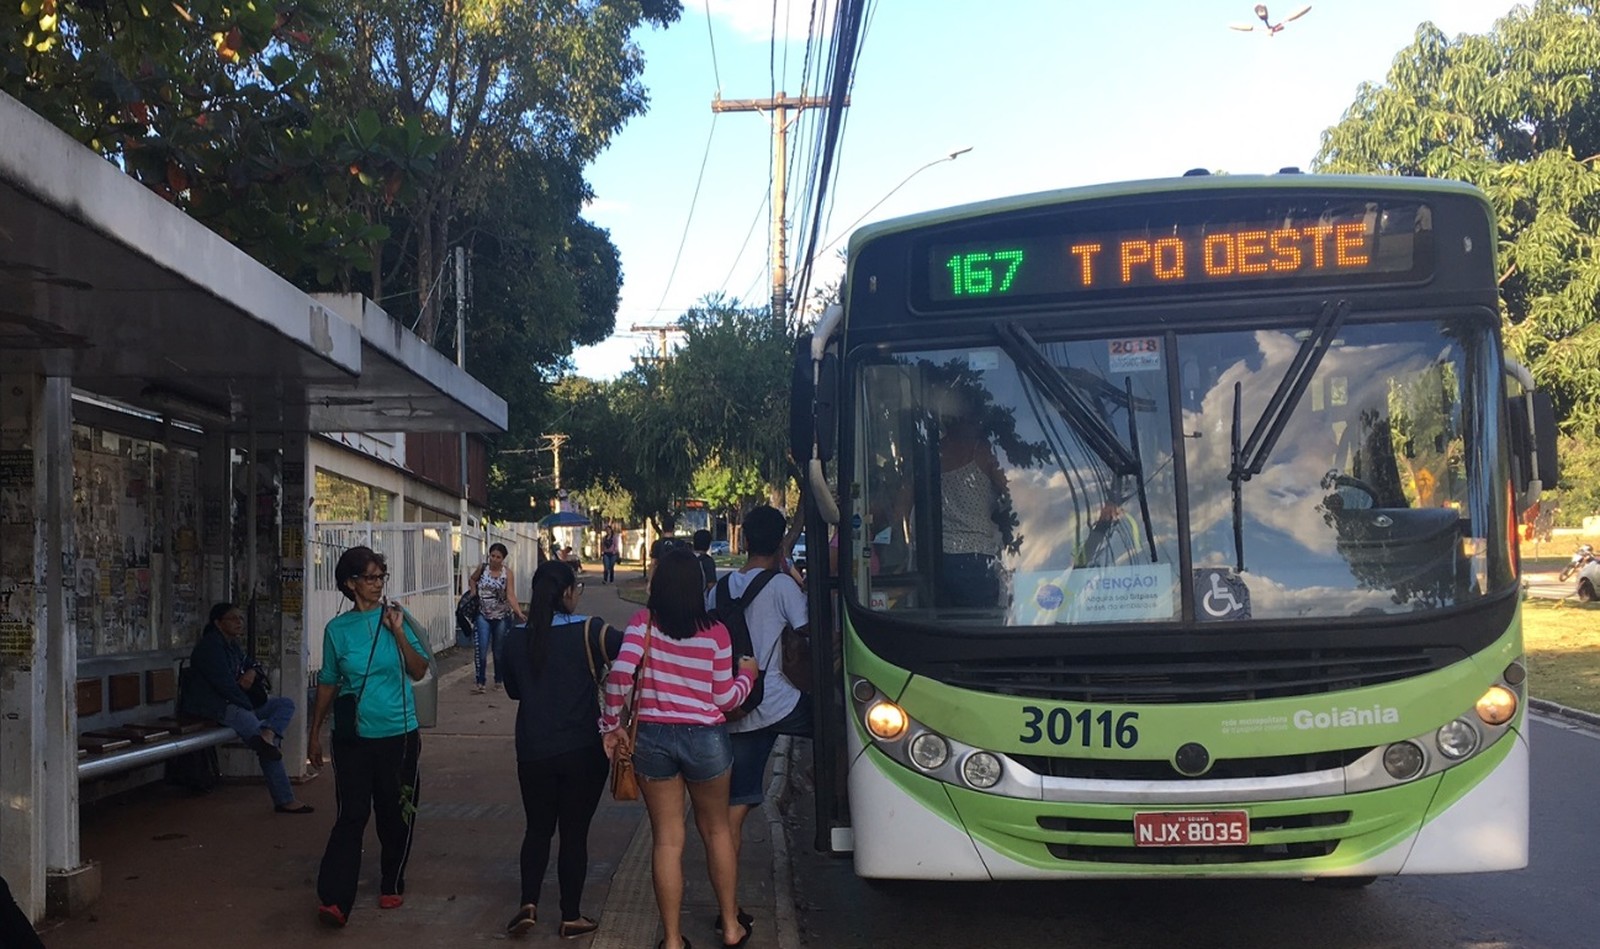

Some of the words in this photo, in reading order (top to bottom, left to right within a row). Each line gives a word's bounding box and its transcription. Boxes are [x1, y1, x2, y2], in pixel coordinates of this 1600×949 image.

[946, 250, 1023, 294] 167
[1071, 244, 1101, 285] T
[1121, 237, 1185, 282] PQ
[1204, 223, 1368, 275] OESTE
[1112, 340, 1157, 353] 2018
[1085, 573, 1158, 591] ATENÇÃO!
[1019, 706, 1139, 749] 30116
